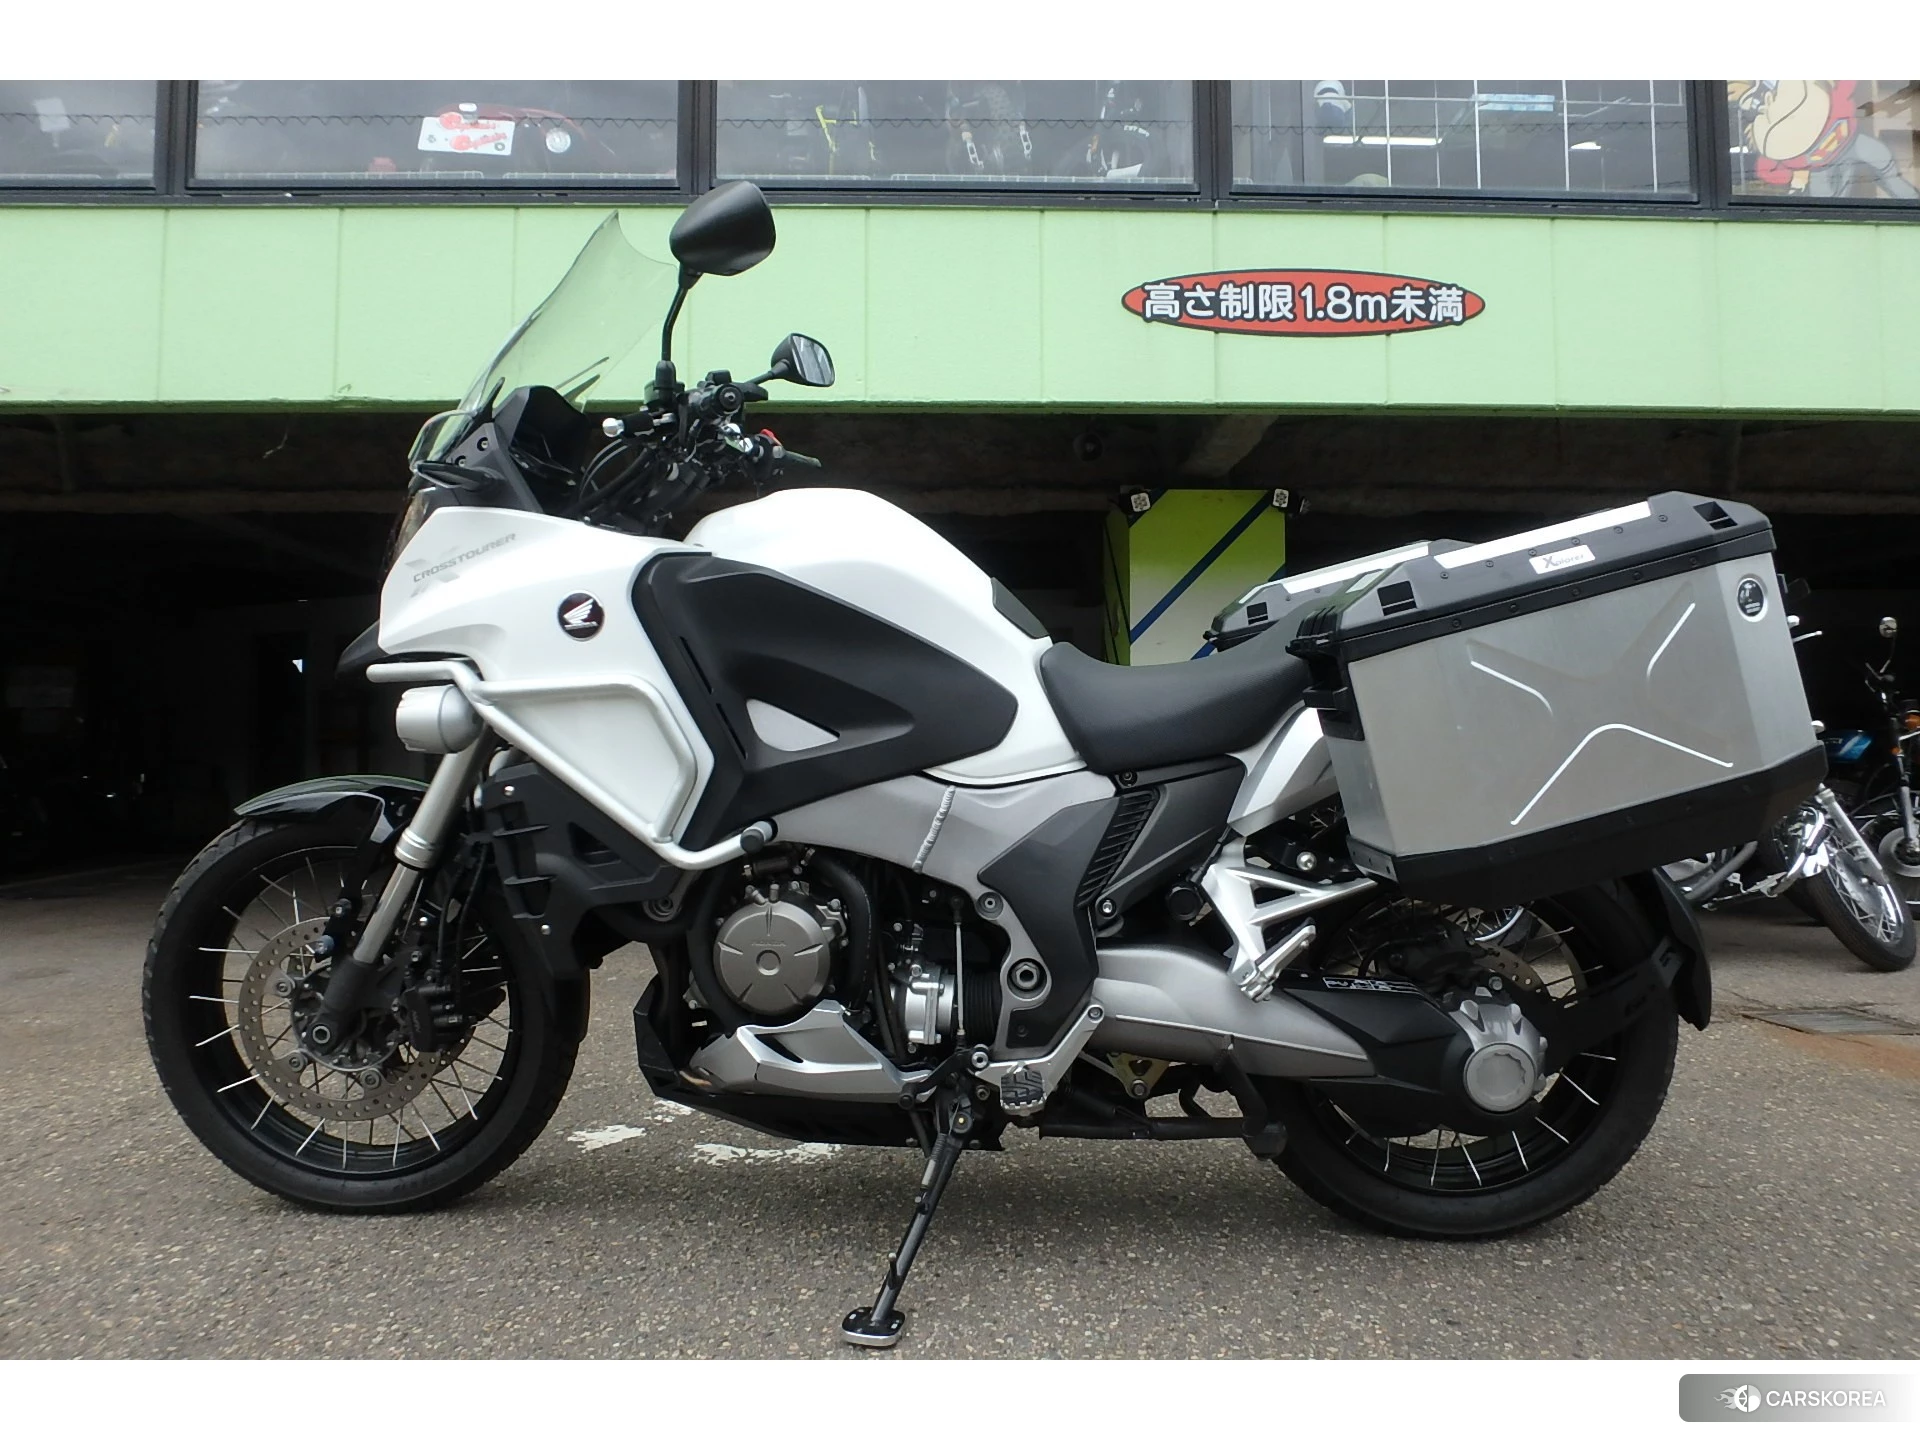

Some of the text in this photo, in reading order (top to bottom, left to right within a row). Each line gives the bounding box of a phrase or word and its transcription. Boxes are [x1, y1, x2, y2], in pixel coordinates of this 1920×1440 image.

[1143, 282, 1464, 322] 高さ制限1.8m未満
[413, 533, 516, 583] CROSSTOURER
